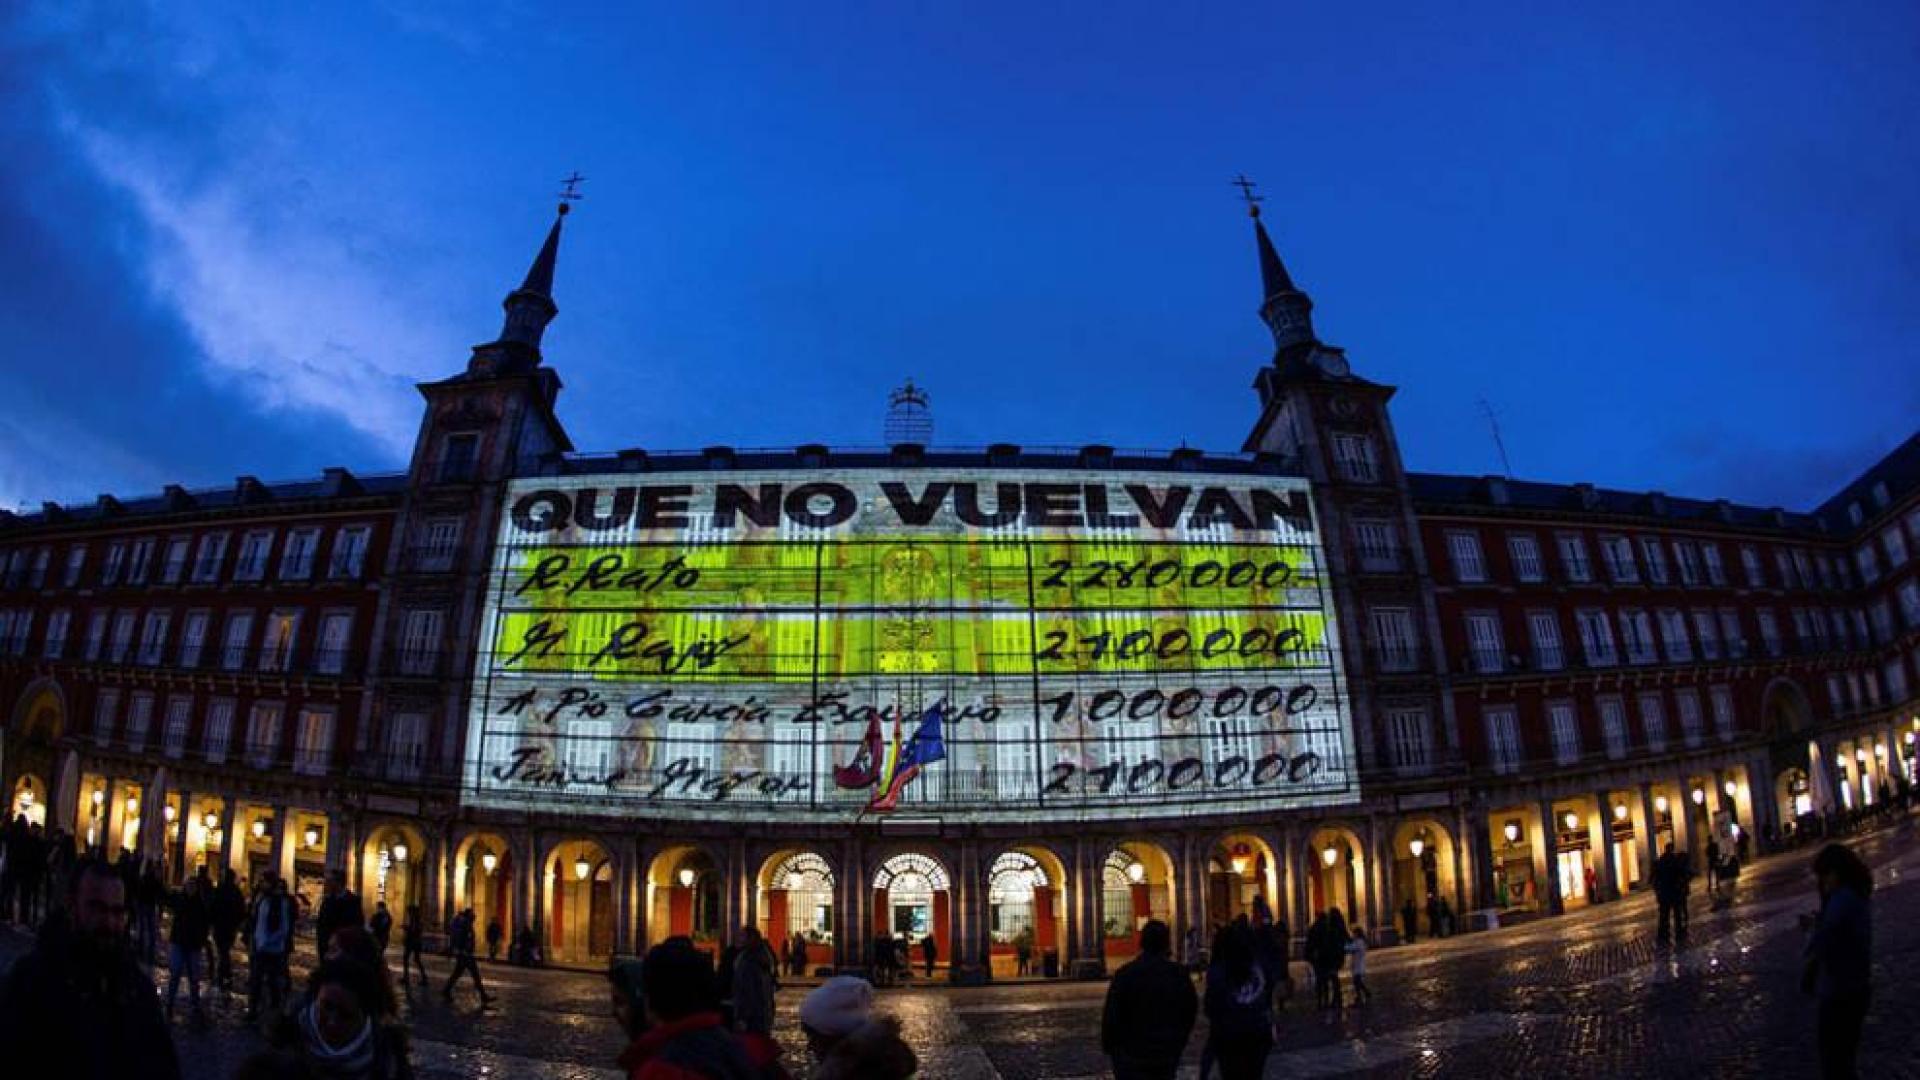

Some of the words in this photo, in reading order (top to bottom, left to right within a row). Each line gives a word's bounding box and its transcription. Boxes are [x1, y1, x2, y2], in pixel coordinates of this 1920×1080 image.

[511, 485, 693, 532] QUE
[714, 482, 858, 529] NO
[879, 482, 1314, 531] VUELVAN
